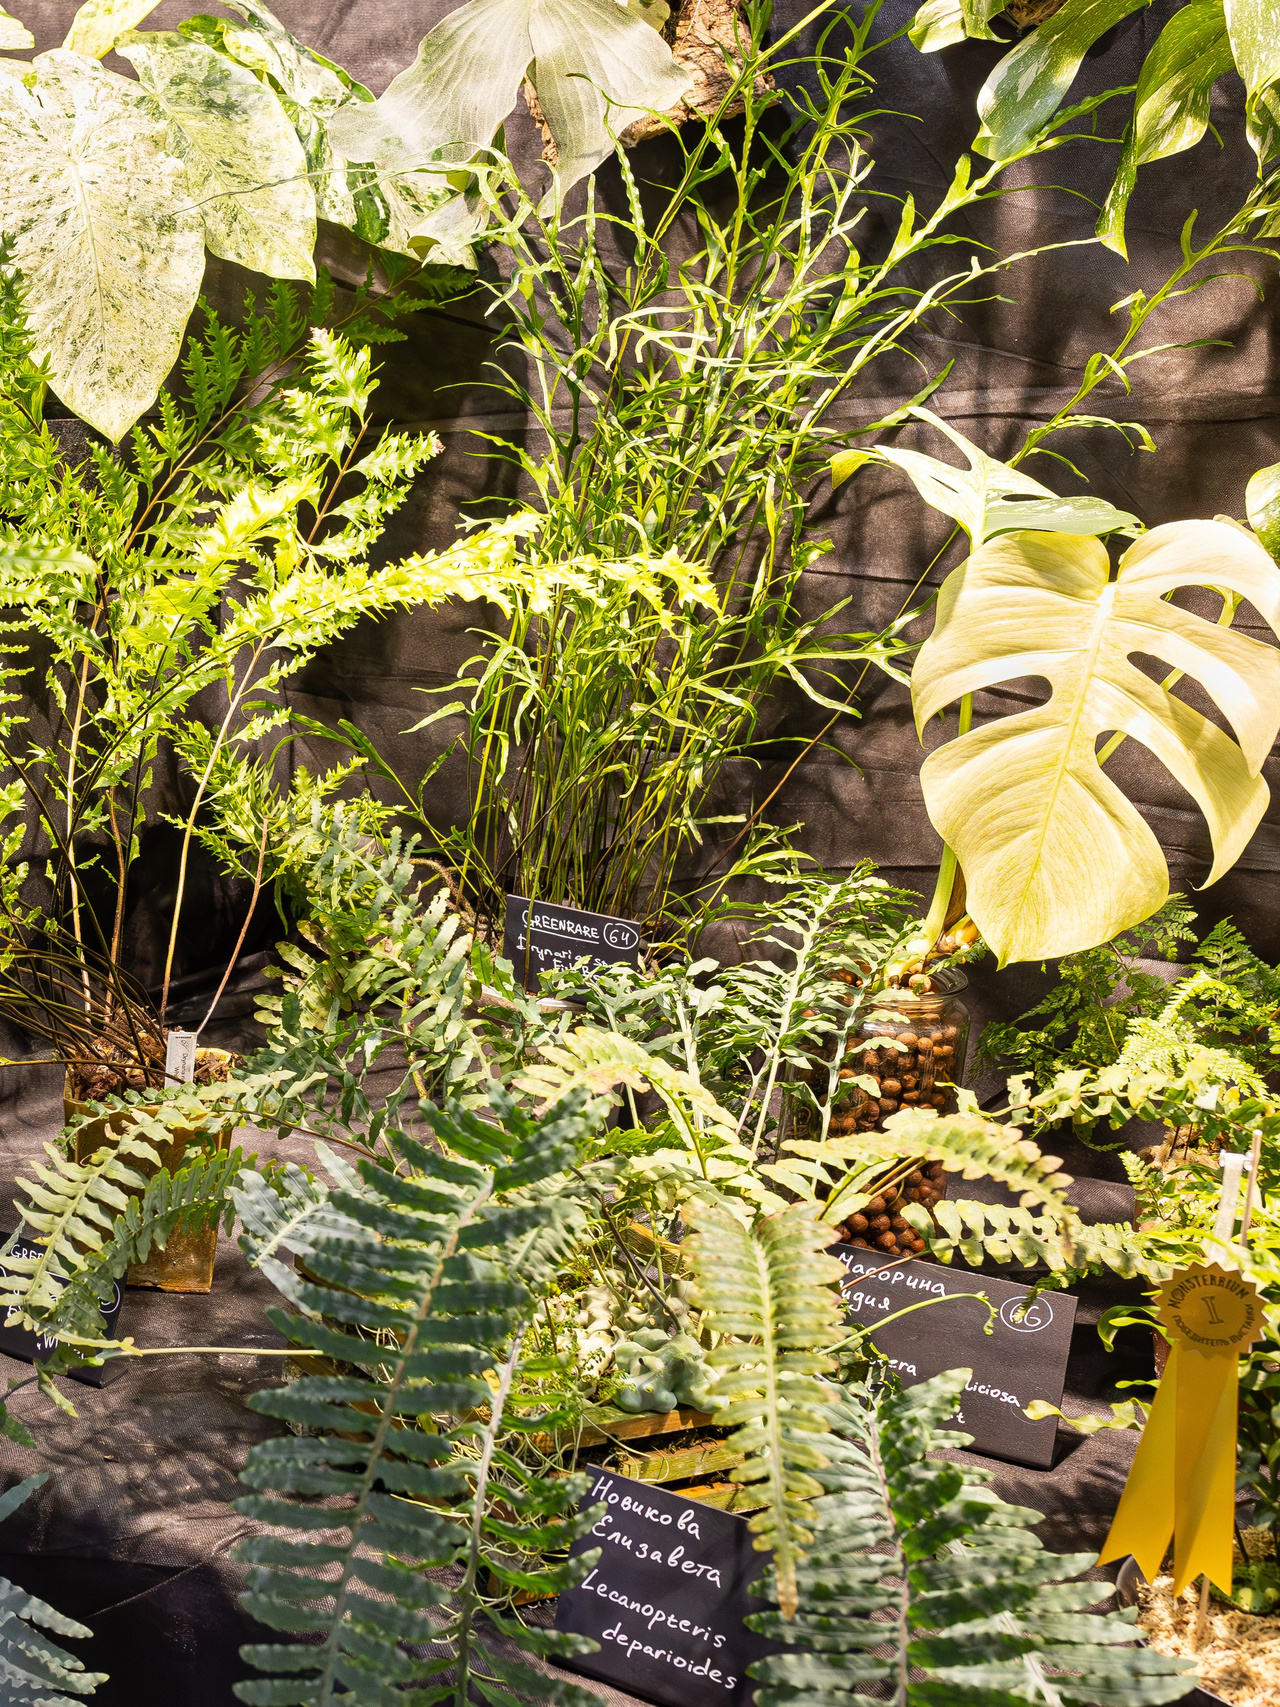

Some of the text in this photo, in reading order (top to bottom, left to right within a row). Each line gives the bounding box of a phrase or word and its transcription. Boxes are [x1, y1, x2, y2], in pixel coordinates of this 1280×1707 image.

[521, 909, 600, 939] GREENRARE
[838, 1280, 890, 1312] идия
[591, 1475, 702, 1541] Новикова
[591, 1514, 722, 1589] Елизавета
[580, 1567, 727, 1649] Lecanopteris
[601, 1621, 738, 1691] deparioides
